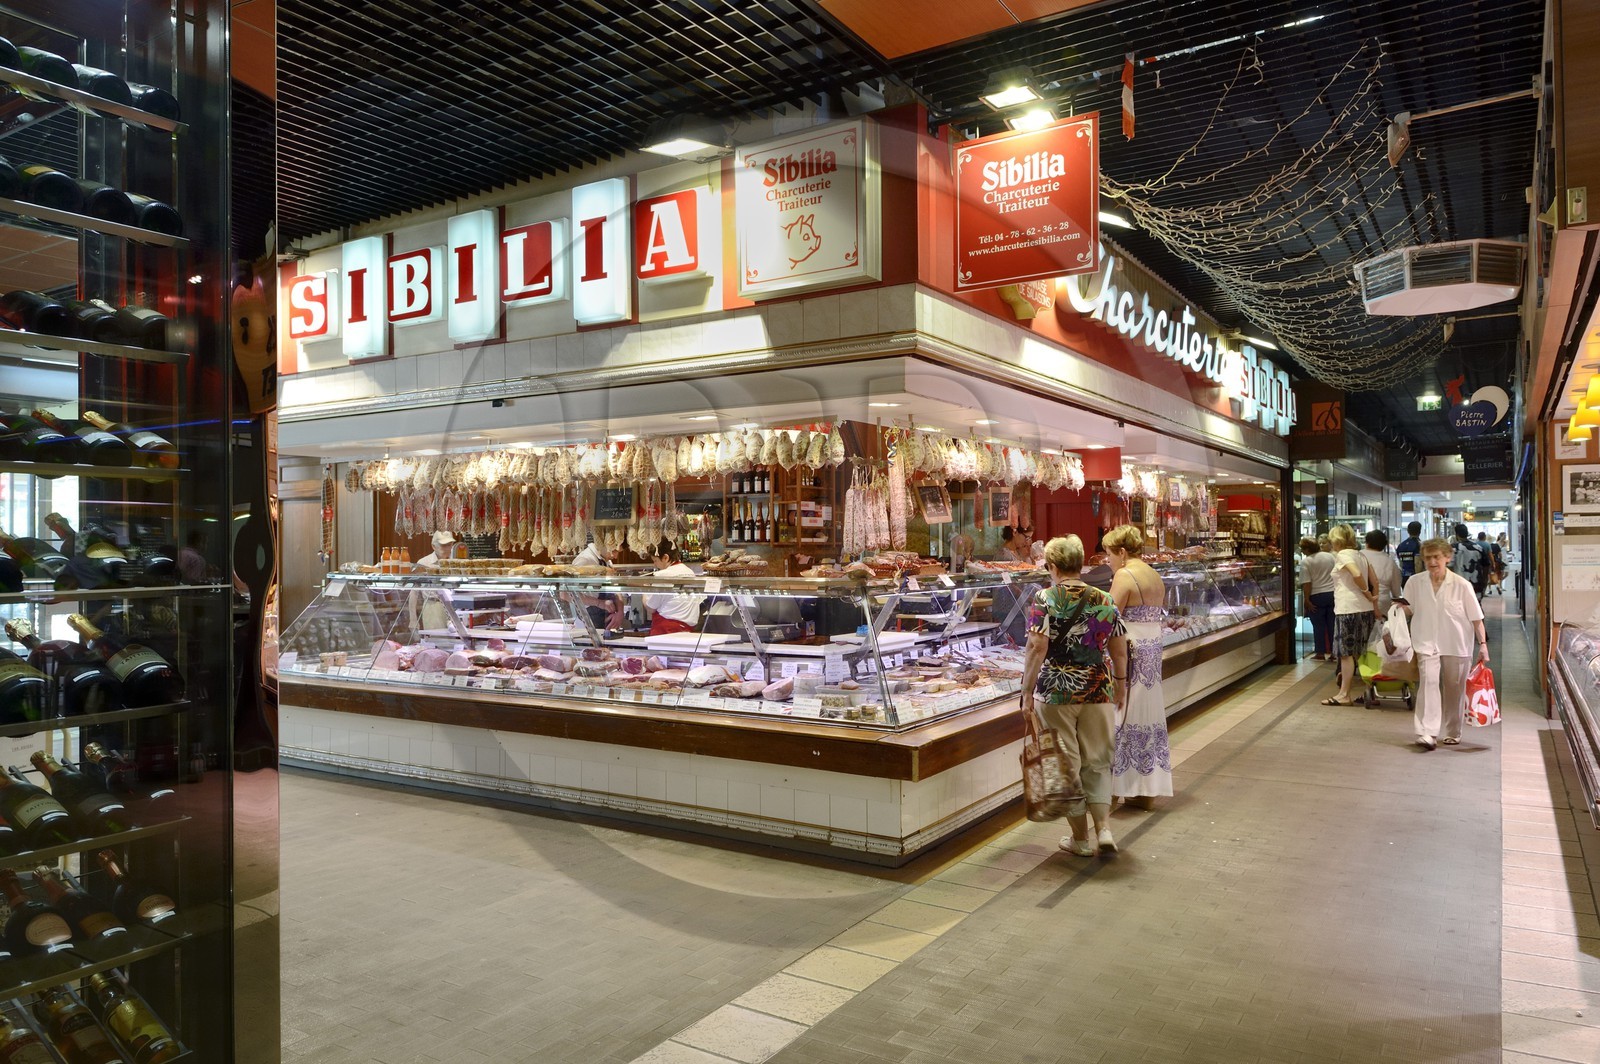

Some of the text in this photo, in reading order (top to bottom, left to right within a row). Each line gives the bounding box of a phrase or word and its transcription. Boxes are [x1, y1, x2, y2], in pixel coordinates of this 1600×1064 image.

[763, 148, 837, 187] Sibilia
[981, 151, 1066, 191] Sibilia
[765, 178, 831, 202] Charcuterie
[983, 180, 1060, 204] Charcuterie
[778, 195, 823, 212] Traiteur
[997, 196, 1050, 214] Traiteur
[968, 232, 1081, 257] www.charcuteriesibilia.com
[978, 235, 994, 244] Tél:
[994, 233, 1004, 241] 04
[1010, 230, 1020, 238] 78
[1026, 228, 1036, 236] 62
[1042, 225, 1052, 233] 36
[1059, 221, 1069, 230] 28
[290, 199, 696, 336] SIBILIA
[1461, 410, 1484, 418] Pierre
[1467, 461, 1504, 470] CELLERIER
